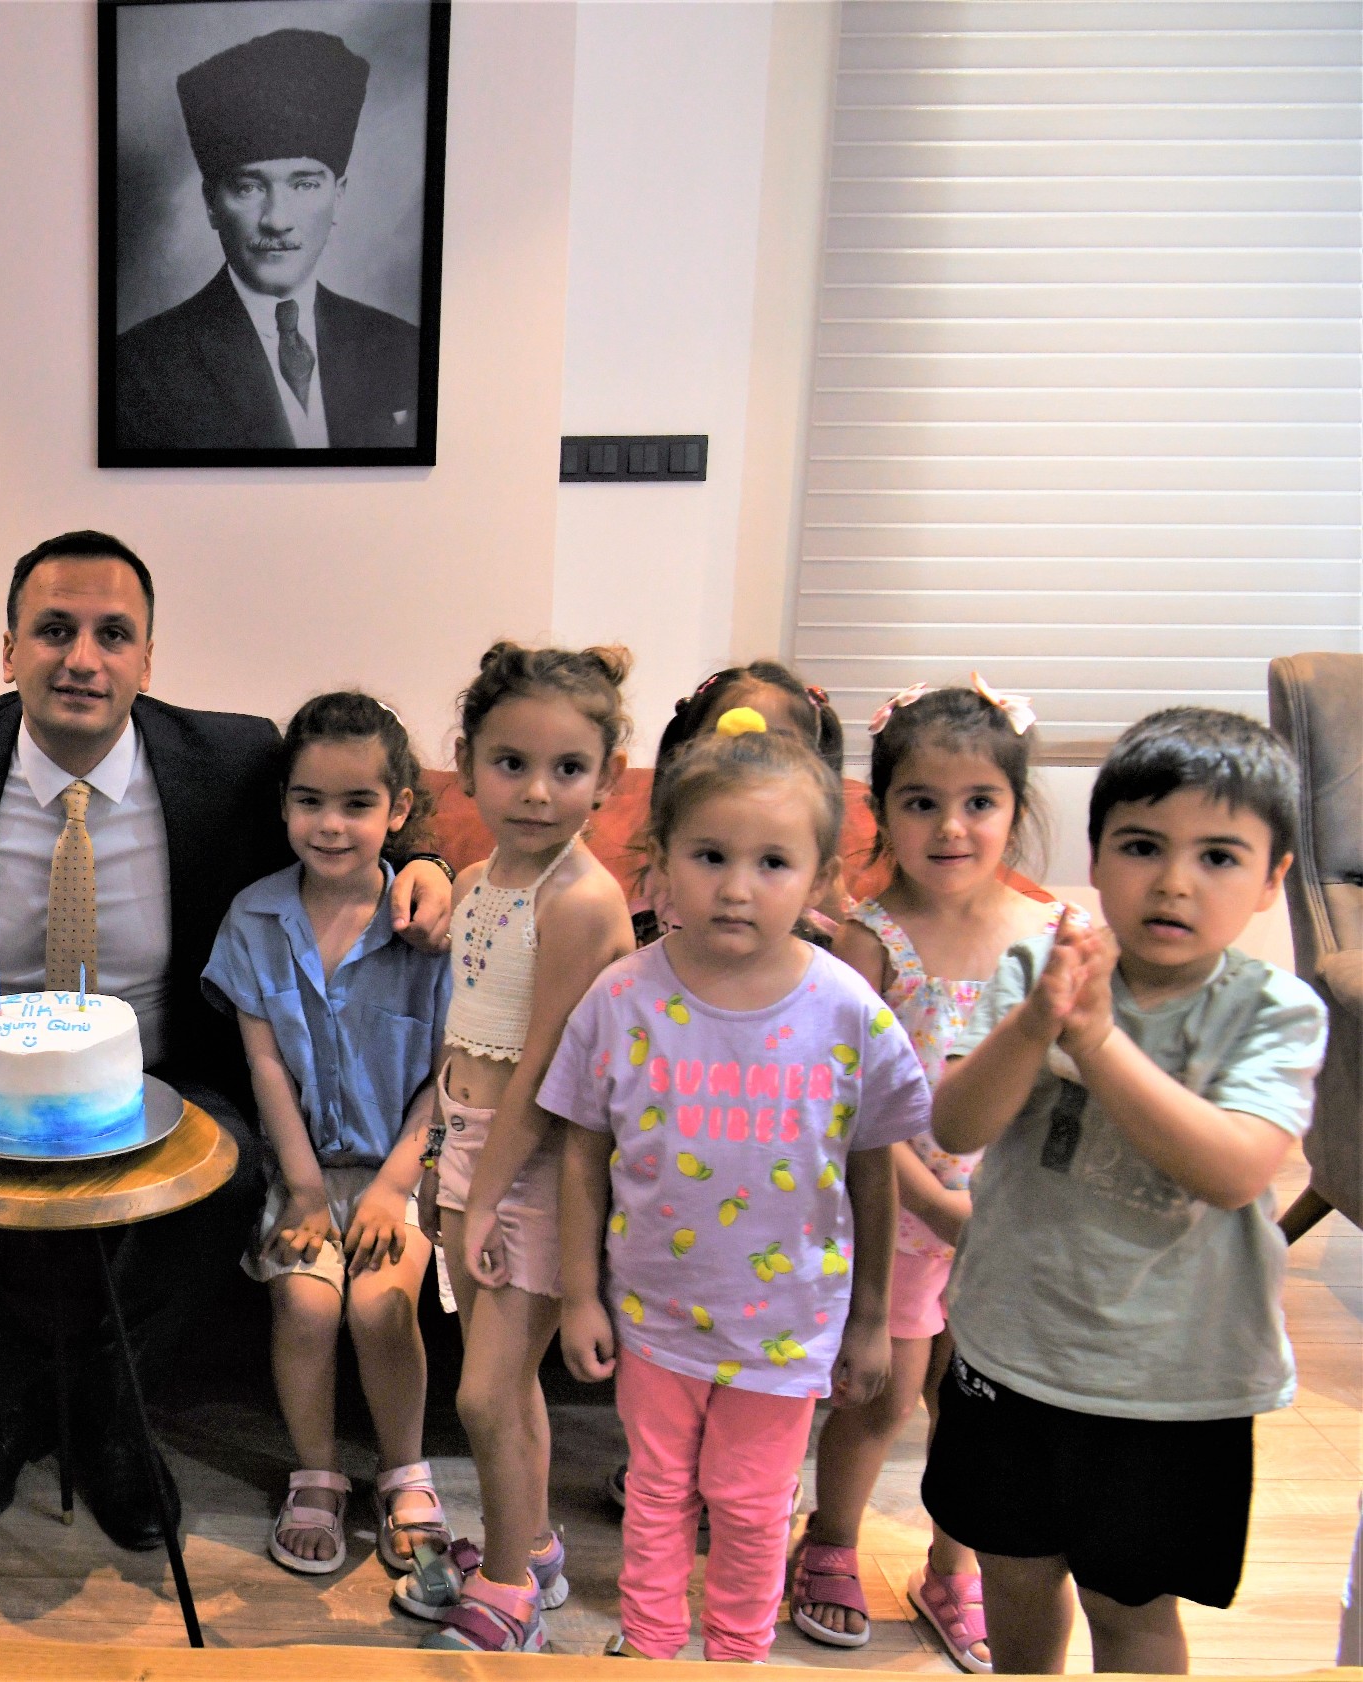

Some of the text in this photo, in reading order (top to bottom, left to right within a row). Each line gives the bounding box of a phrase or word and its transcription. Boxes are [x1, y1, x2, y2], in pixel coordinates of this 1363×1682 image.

[1, 993, 42, 1004] 20
[649, 1056, 834, 1101] SUMMER
[677, 1104, 801, 1143] VIBES
